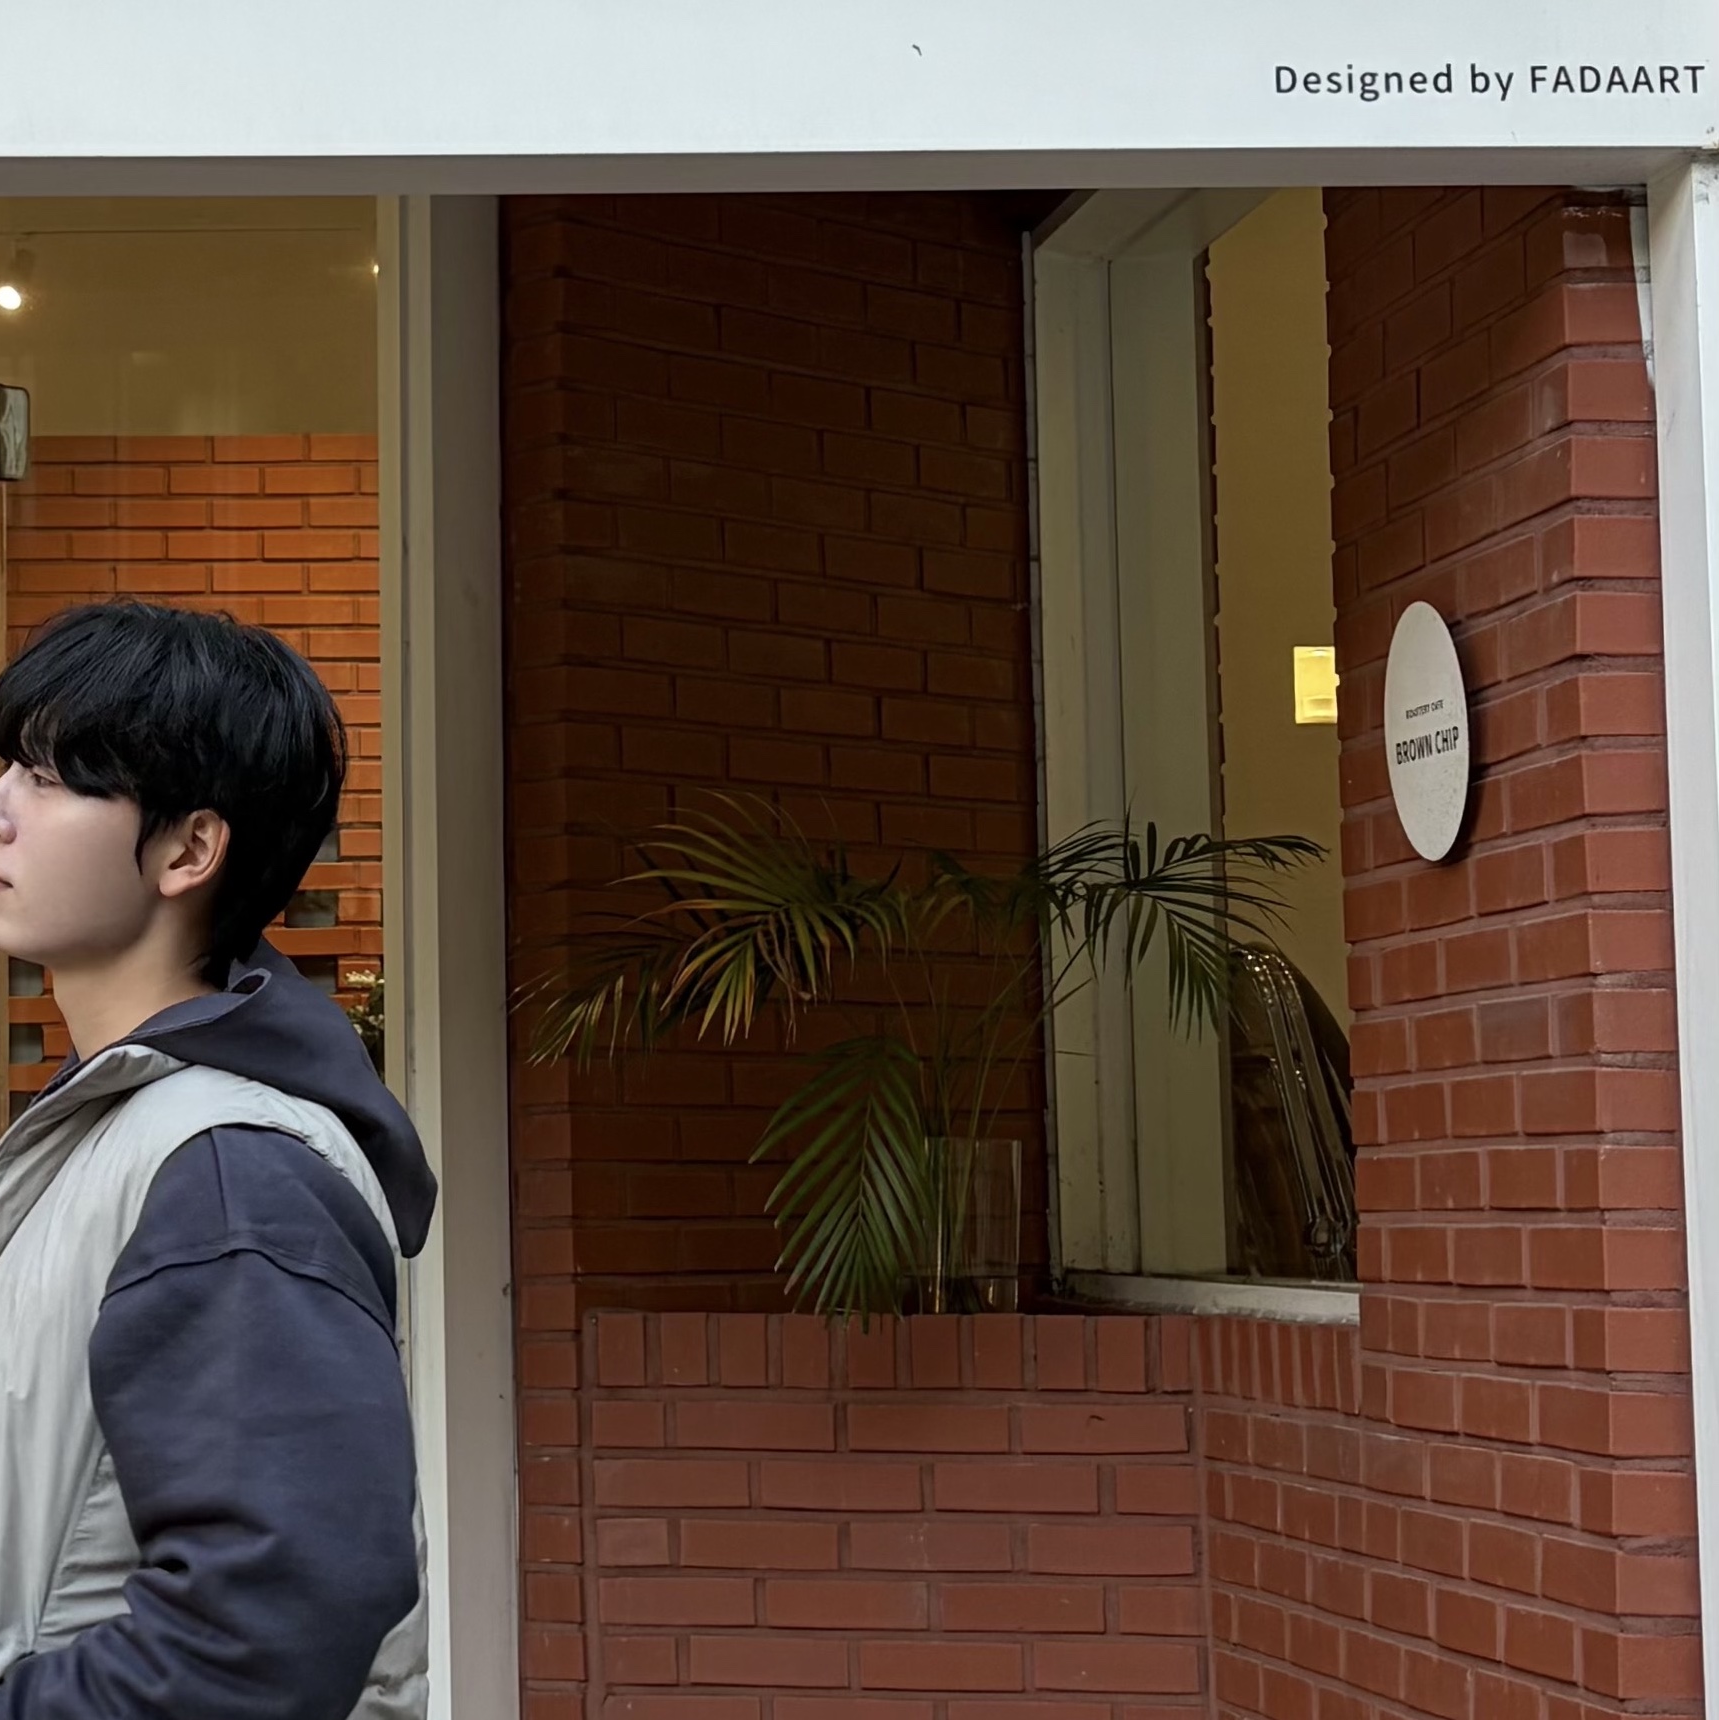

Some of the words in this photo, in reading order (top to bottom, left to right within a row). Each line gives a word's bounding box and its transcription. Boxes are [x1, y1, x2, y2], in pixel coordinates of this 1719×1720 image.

[1275, 63, 1452, 101] Designed
[1470, 63, 1514, 100] by
[1530, 65, 1706, 93] FADAART
[1395, 733, 1433, 765] BROWN
[1435, 726, 1459, 754] CHIP
